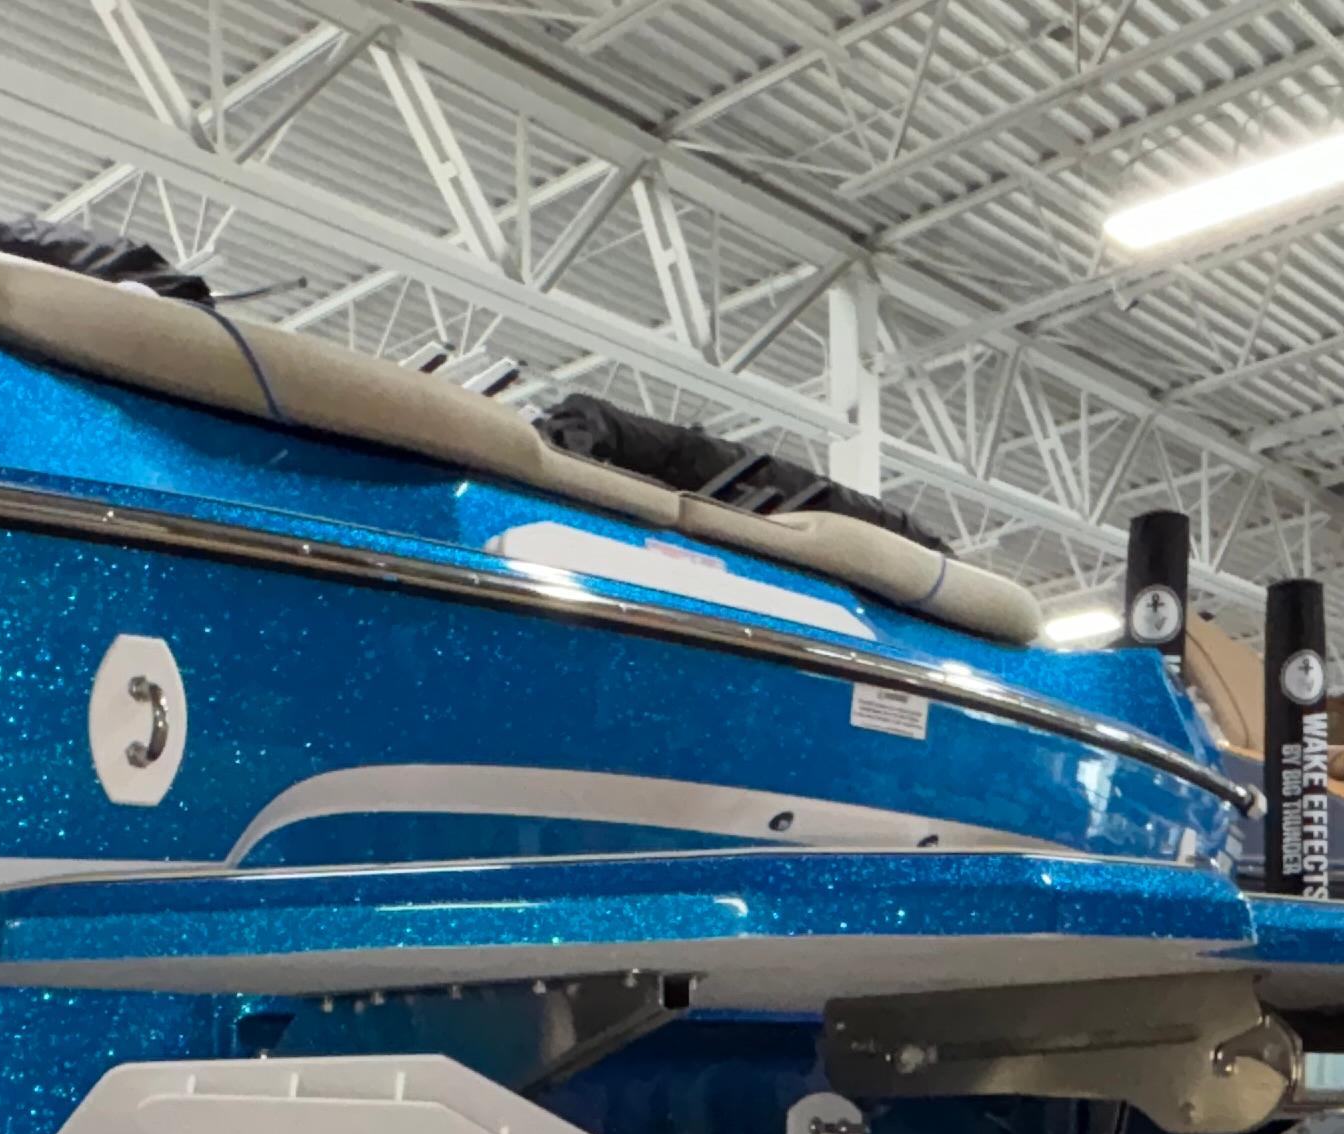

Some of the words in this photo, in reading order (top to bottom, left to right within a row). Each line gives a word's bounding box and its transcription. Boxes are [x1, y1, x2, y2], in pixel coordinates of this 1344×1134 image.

[1302, 712, 1329, 788] WAKE
[1282, 801, 1303, 876] THUNDER
[1302, 794, 1329, 900] EFFECTS
